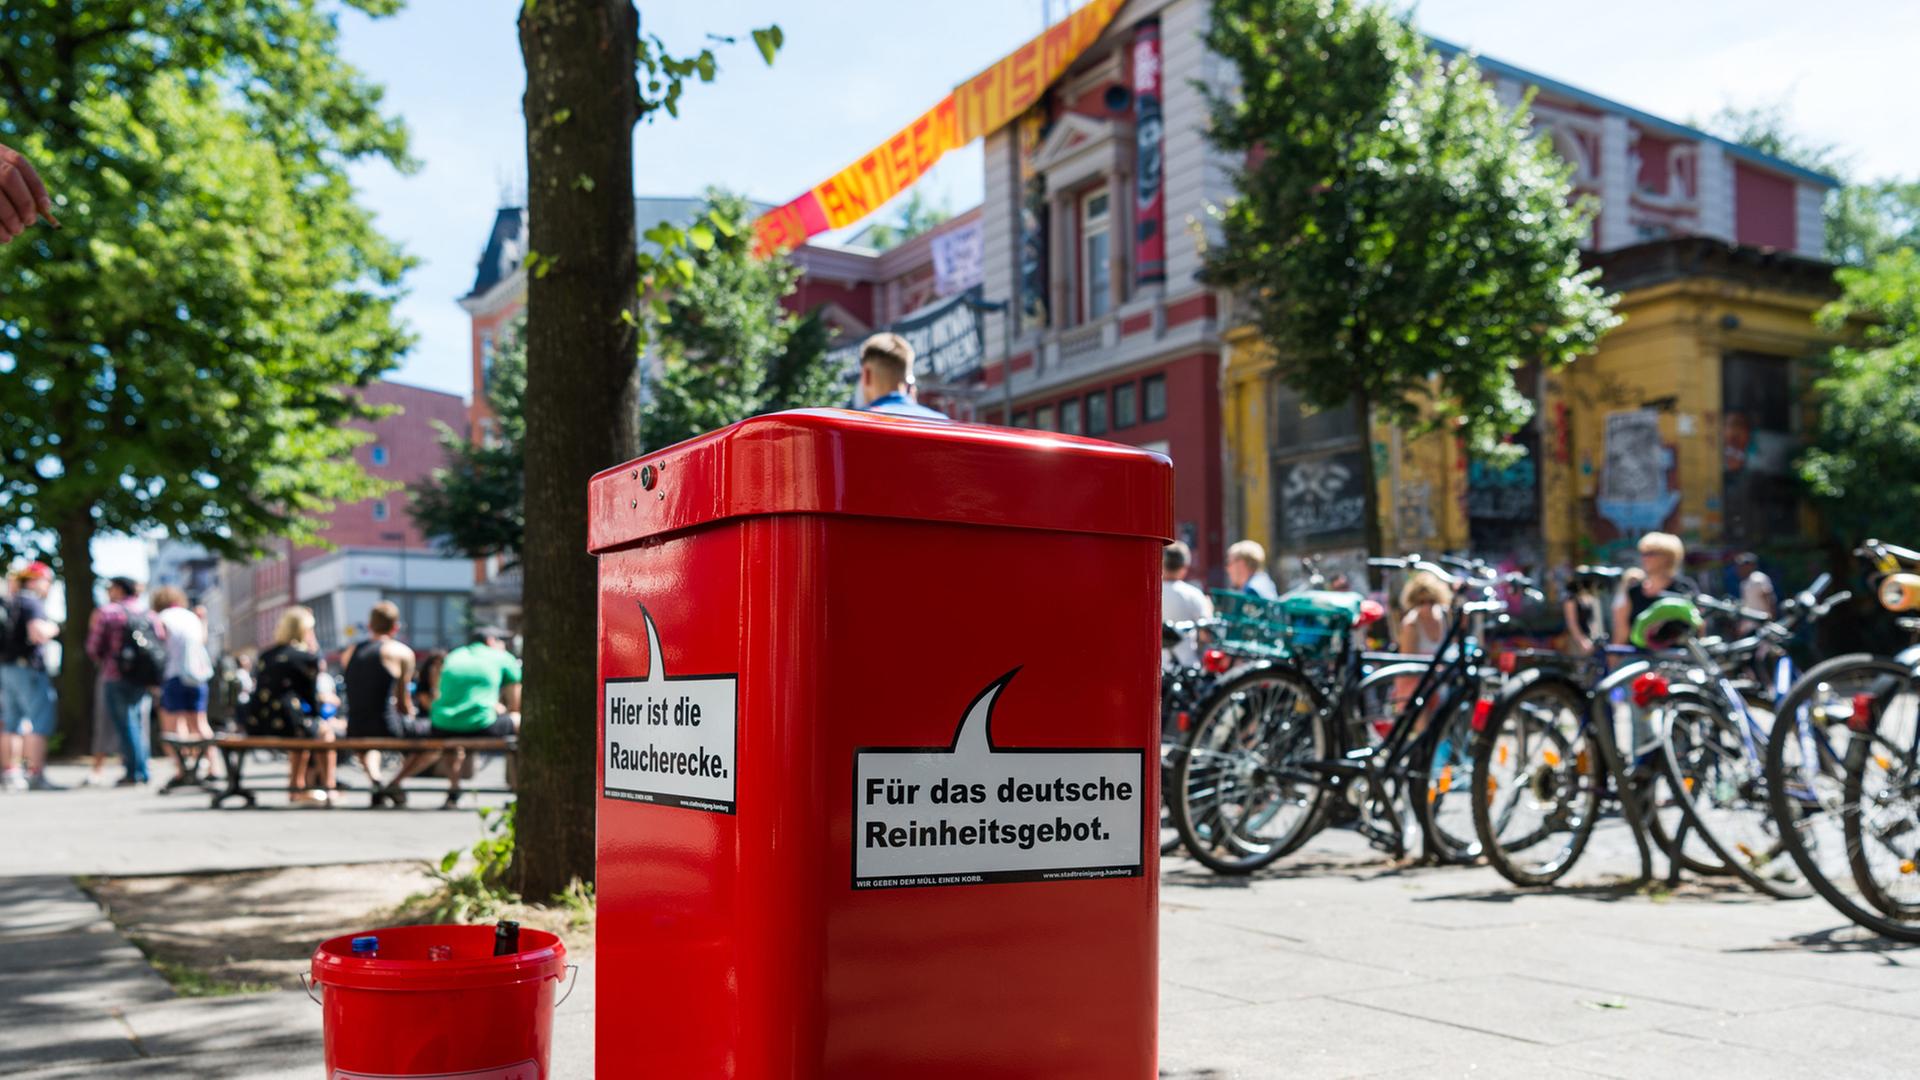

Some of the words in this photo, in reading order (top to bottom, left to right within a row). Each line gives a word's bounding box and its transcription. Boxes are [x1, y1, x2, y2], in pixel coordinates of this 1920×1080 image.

[611, 697, 642, 725] Hier
[648, 697, 668, 726] ist
[674, 696, 701, 726] die
[610, 741, 728, 778] Raucherecke.
[866, 778, 920, 804] Für
[930, 778, 986, 803] das
[997, 777, 1132, 802] deutsche
[866, 817, 1110, 849] Reinheitsgebot.
[873, 879, 898, 887] GEBEN
[1043, 869, 1132, 878] www.stadtreinigung.hamburg
